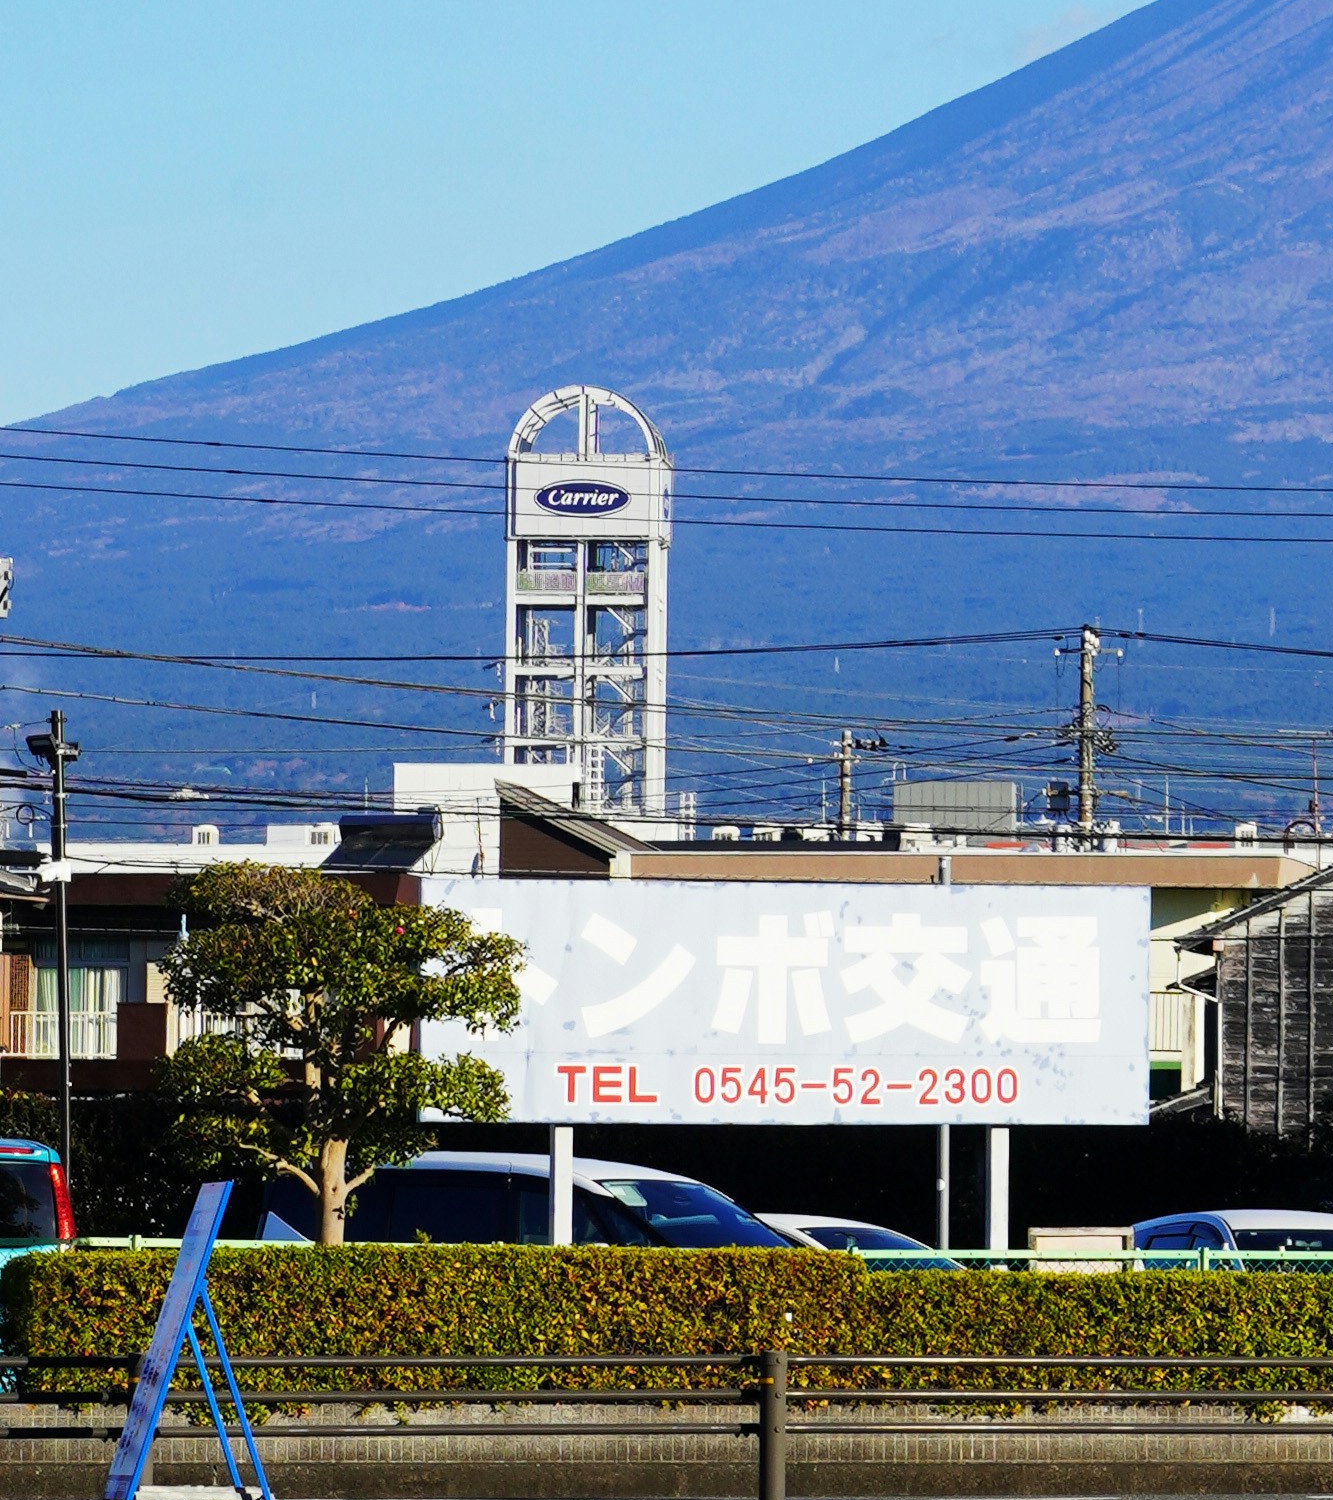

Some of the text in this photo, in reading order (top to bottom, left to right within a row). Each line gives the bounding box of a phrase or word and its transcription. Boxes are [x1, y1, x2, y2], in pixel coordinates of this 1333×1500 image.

[548, 489, 620, 505] Carrier
[559, 1066, 1018, 1105] TEL 0545-52-2300
